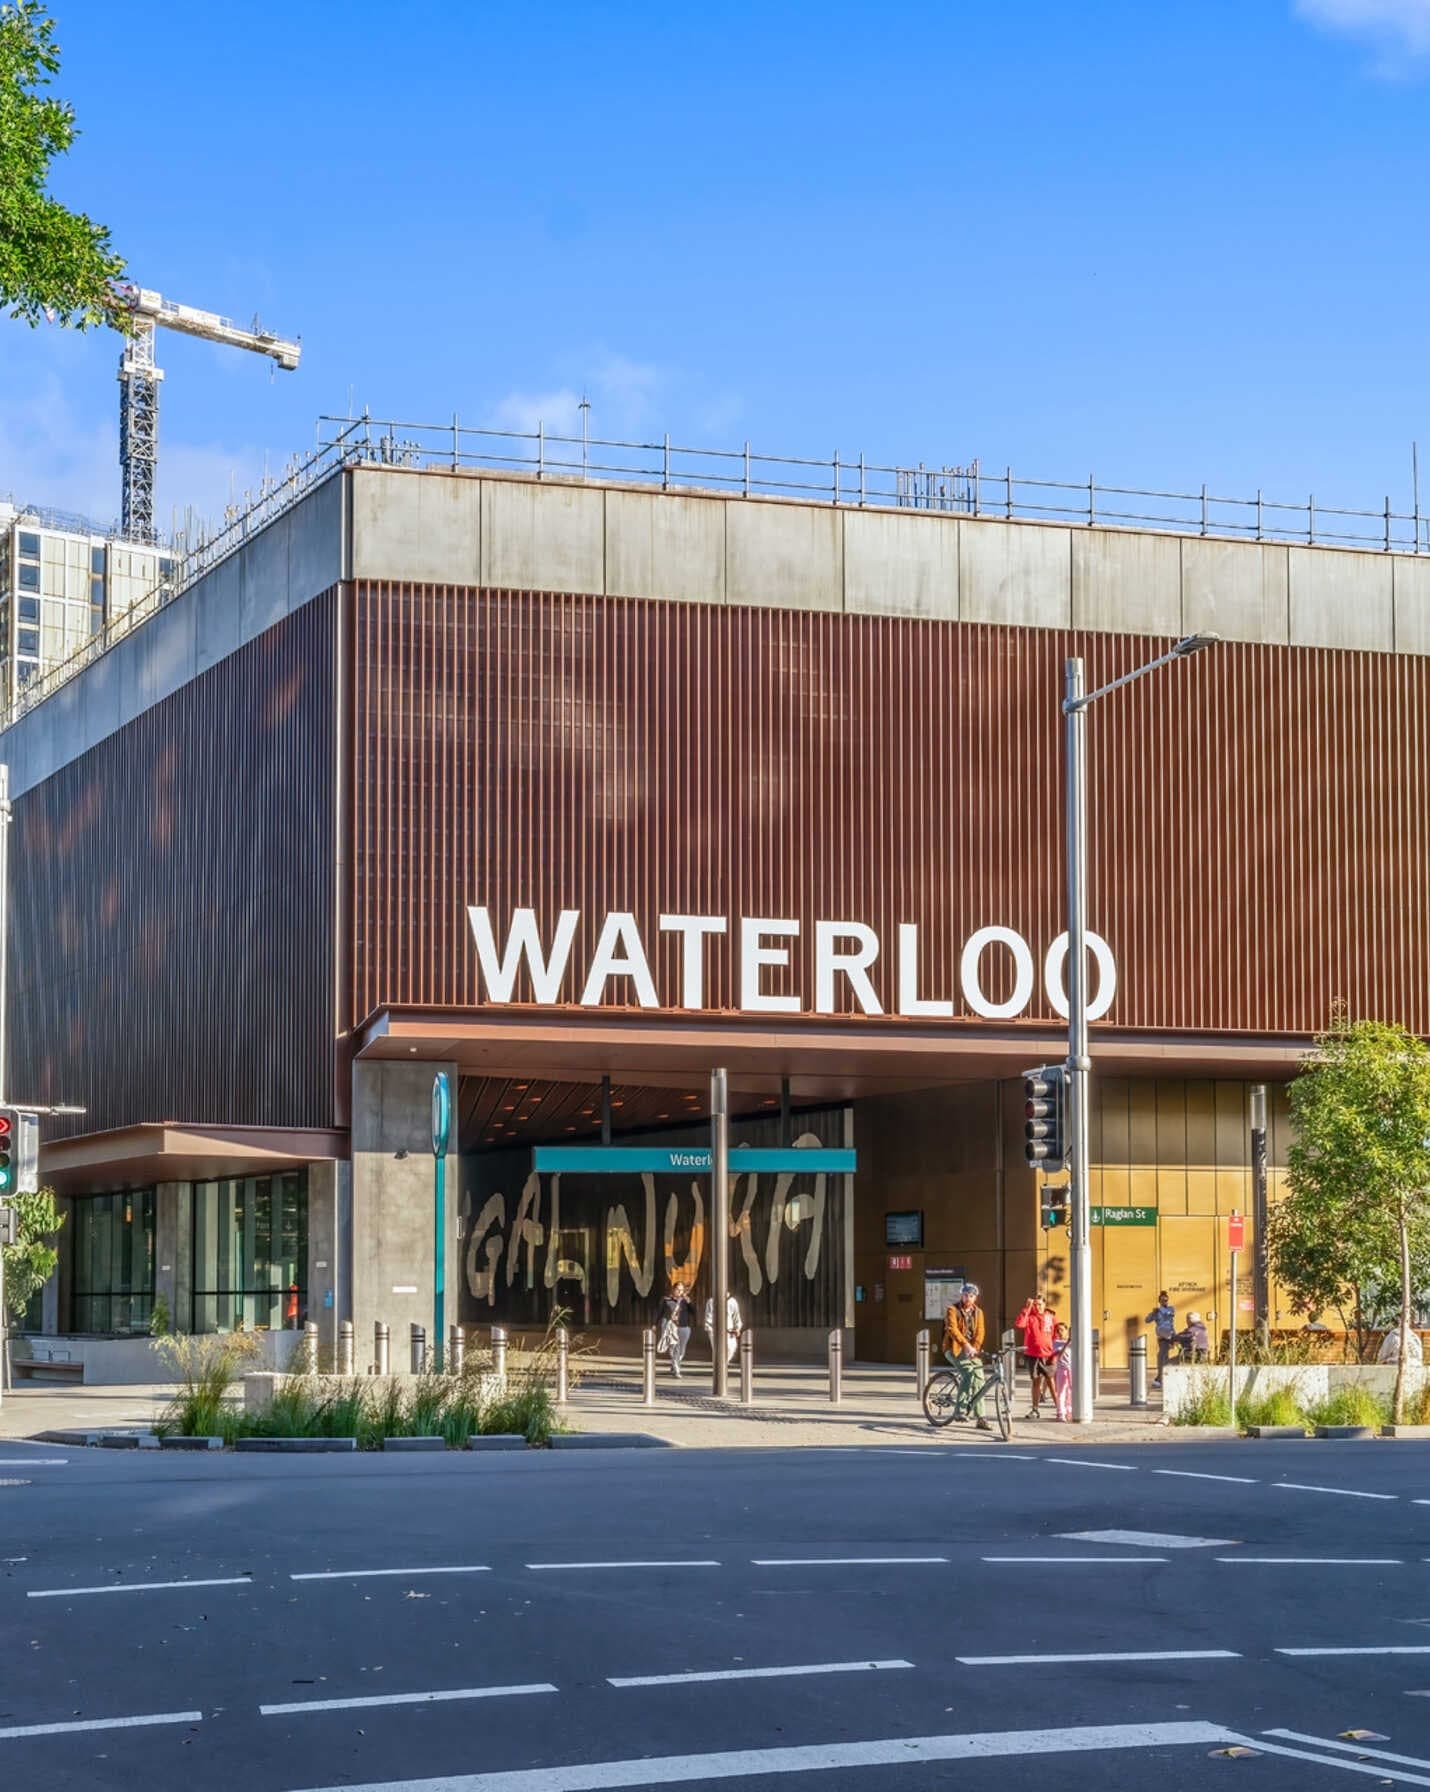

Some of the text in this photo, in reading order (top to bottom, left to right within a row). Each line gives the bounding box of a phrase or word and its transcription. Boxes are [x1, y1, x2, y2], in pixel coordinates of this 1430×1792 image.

[467, 905, 1117, 1020] WATERLOO
[669, 1153, 712, 1166] Waterl
[1105, 1208, 1146, 1221] Raglan St
